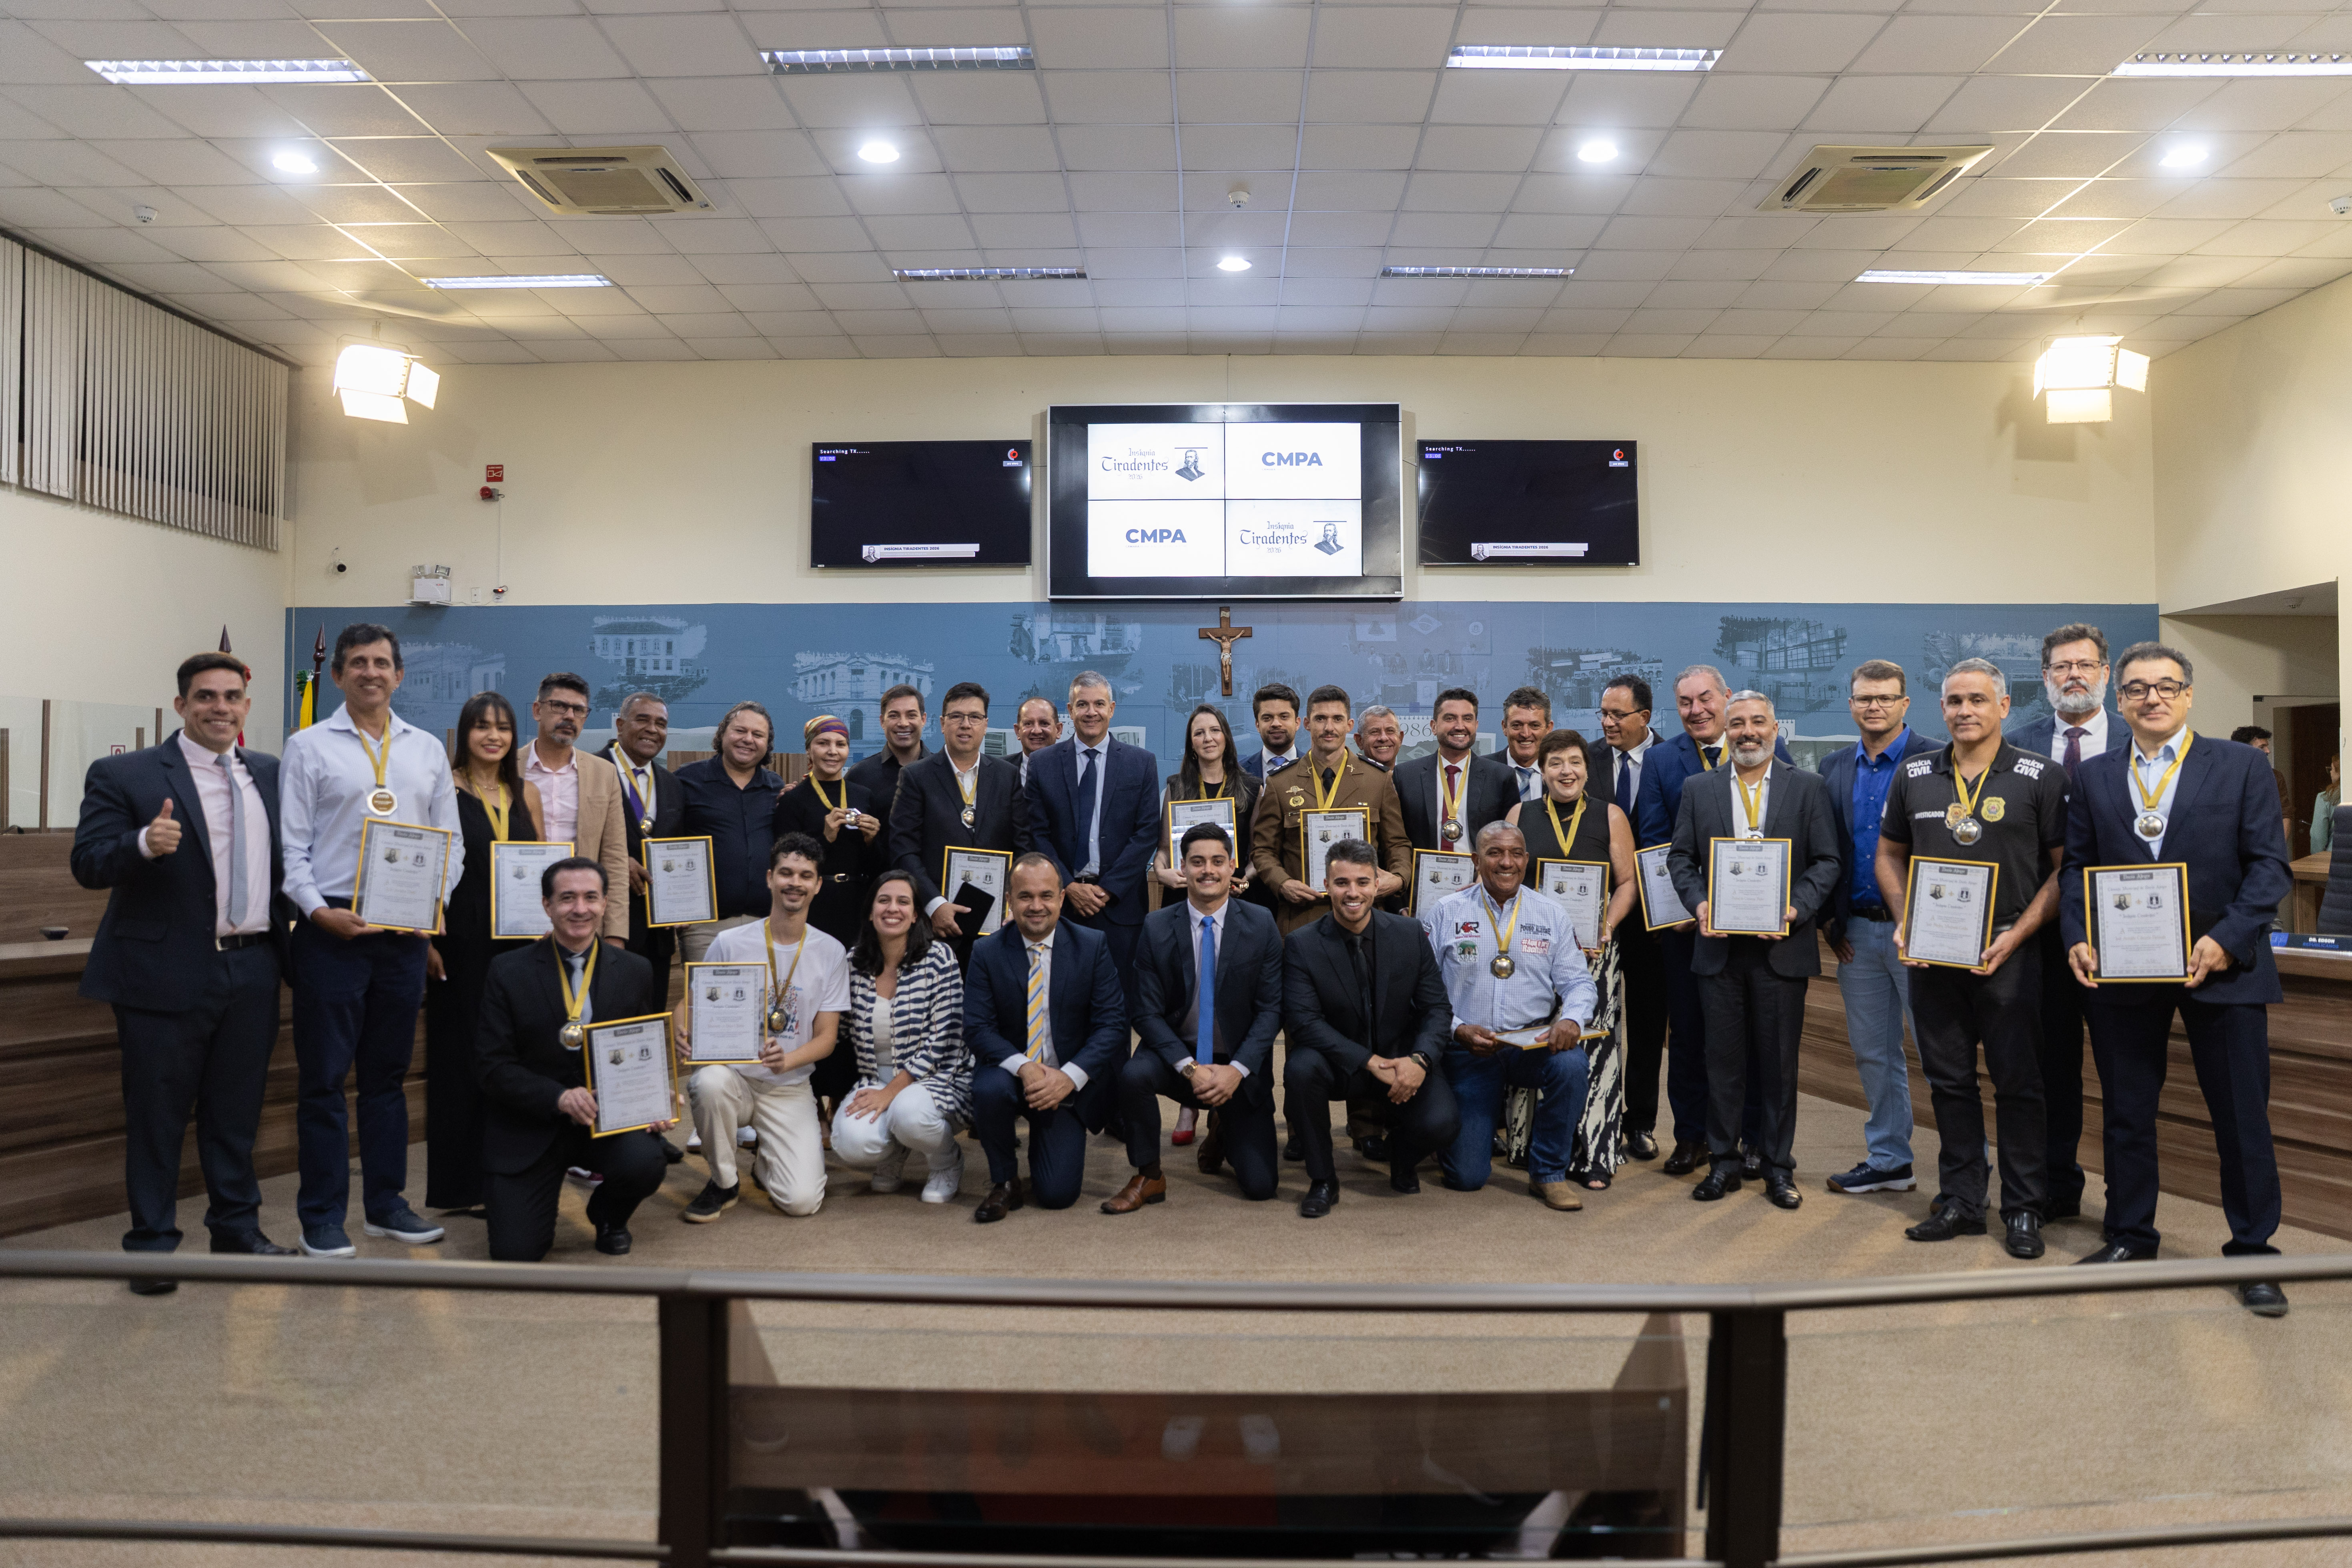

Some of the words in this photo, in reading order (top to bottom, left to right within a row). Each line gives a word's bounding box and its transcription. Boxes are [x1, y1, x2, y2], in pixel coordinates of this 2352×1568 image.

[1129, 448, 1155, 457] Insígnia
[1262, 452, 1323, 466] CMPA
[1101, 456, 1169, 473] Tiradentes
[1267, 521, 1294, 531] Insígnia
[1126, 529, 1187, 543] CMPA
[1240, 529, 1308, 549] Tiradentes
[1400, 723, 1432, 737] 986
[1906, 760, 1932, 770] POLÍCIA
[2017, 758, 2044, 770] POLÍCIA
[1908, 765, 1933, 778] CIVIL
[2013, 764, 2039, 780] CIVIL
[1915, 811, 1945, 819] INVESTIGADOR
[1520, 924, 1534, 932] POUSO
[1536, 925, 1551, 936] ALEGRE
